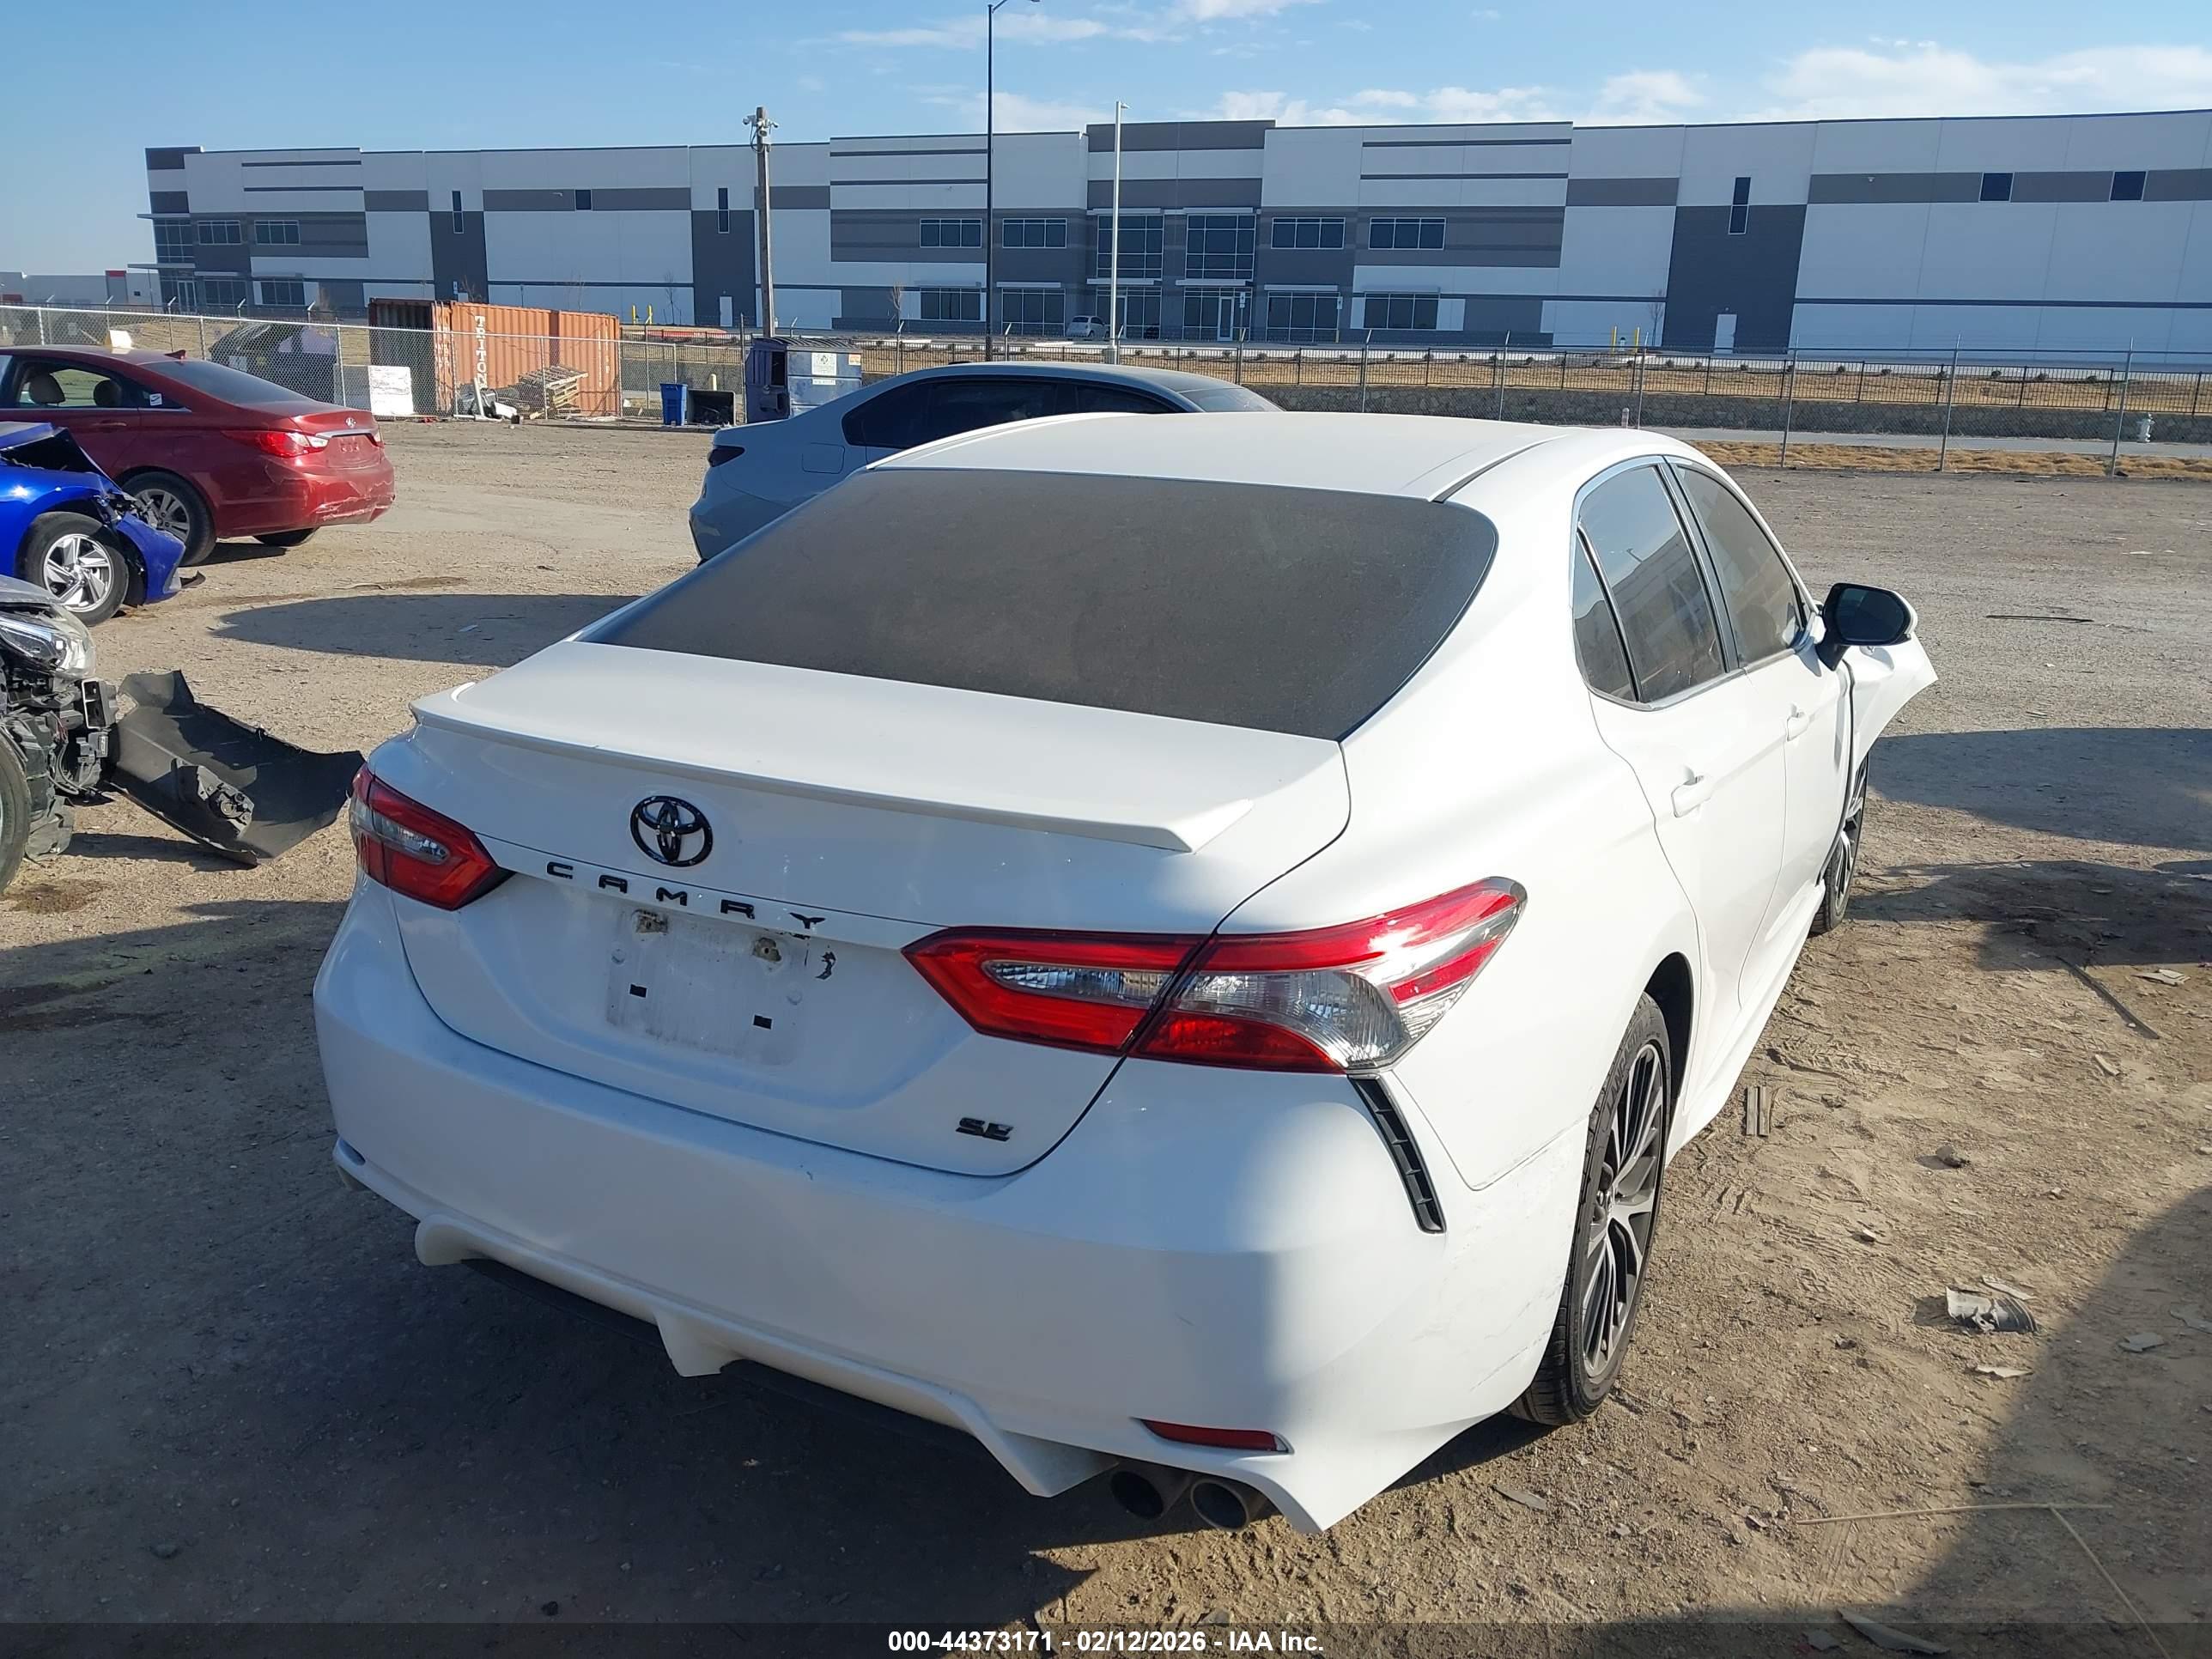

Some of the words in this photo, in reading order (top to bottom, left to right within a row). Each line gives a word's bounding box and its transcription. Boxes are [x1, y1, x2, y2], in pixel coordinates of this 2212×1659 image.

[475, 315, 488, 389] TRITON
[546, 861, 826, 929] CAMRY
[955, 1117, 1014, 1142] SE
